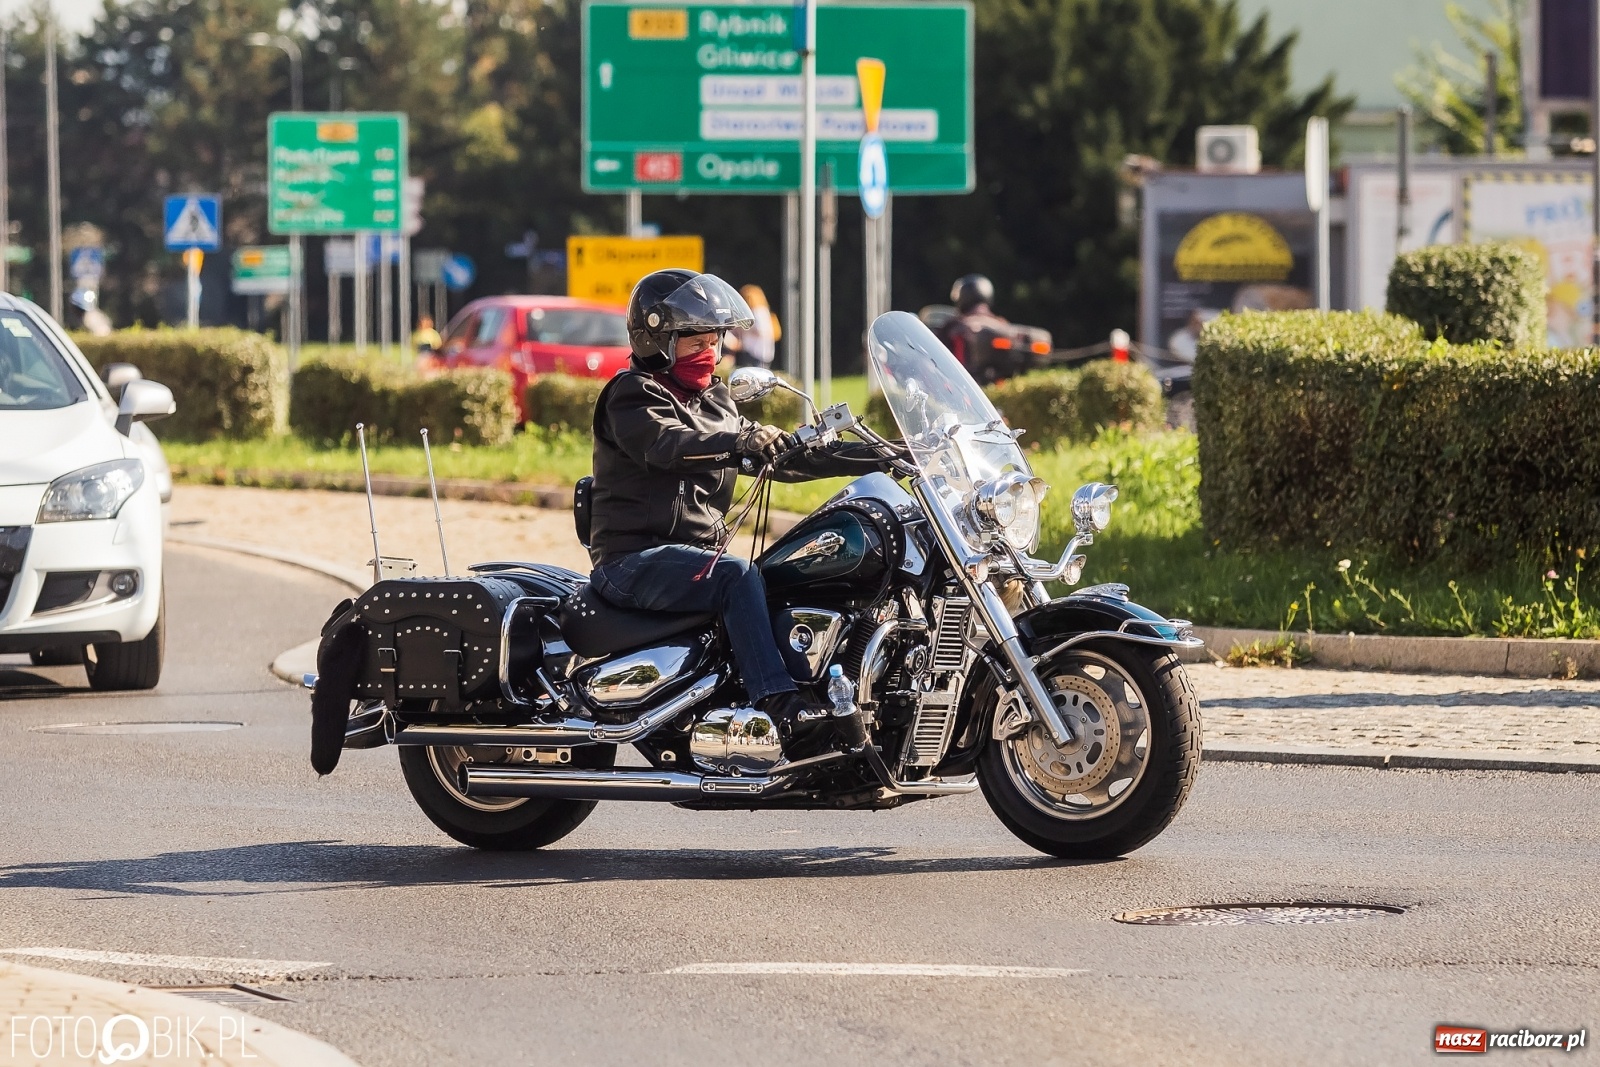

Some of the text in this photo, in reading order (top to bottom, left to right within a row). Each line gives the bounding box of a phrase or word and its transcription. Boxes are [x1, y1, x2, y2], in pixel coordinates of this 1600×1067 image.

[699, 9, 786, 38] Rybnik
[698, 43, 799, 69] Gliwice
[697, 153, 780, 181] Opole
